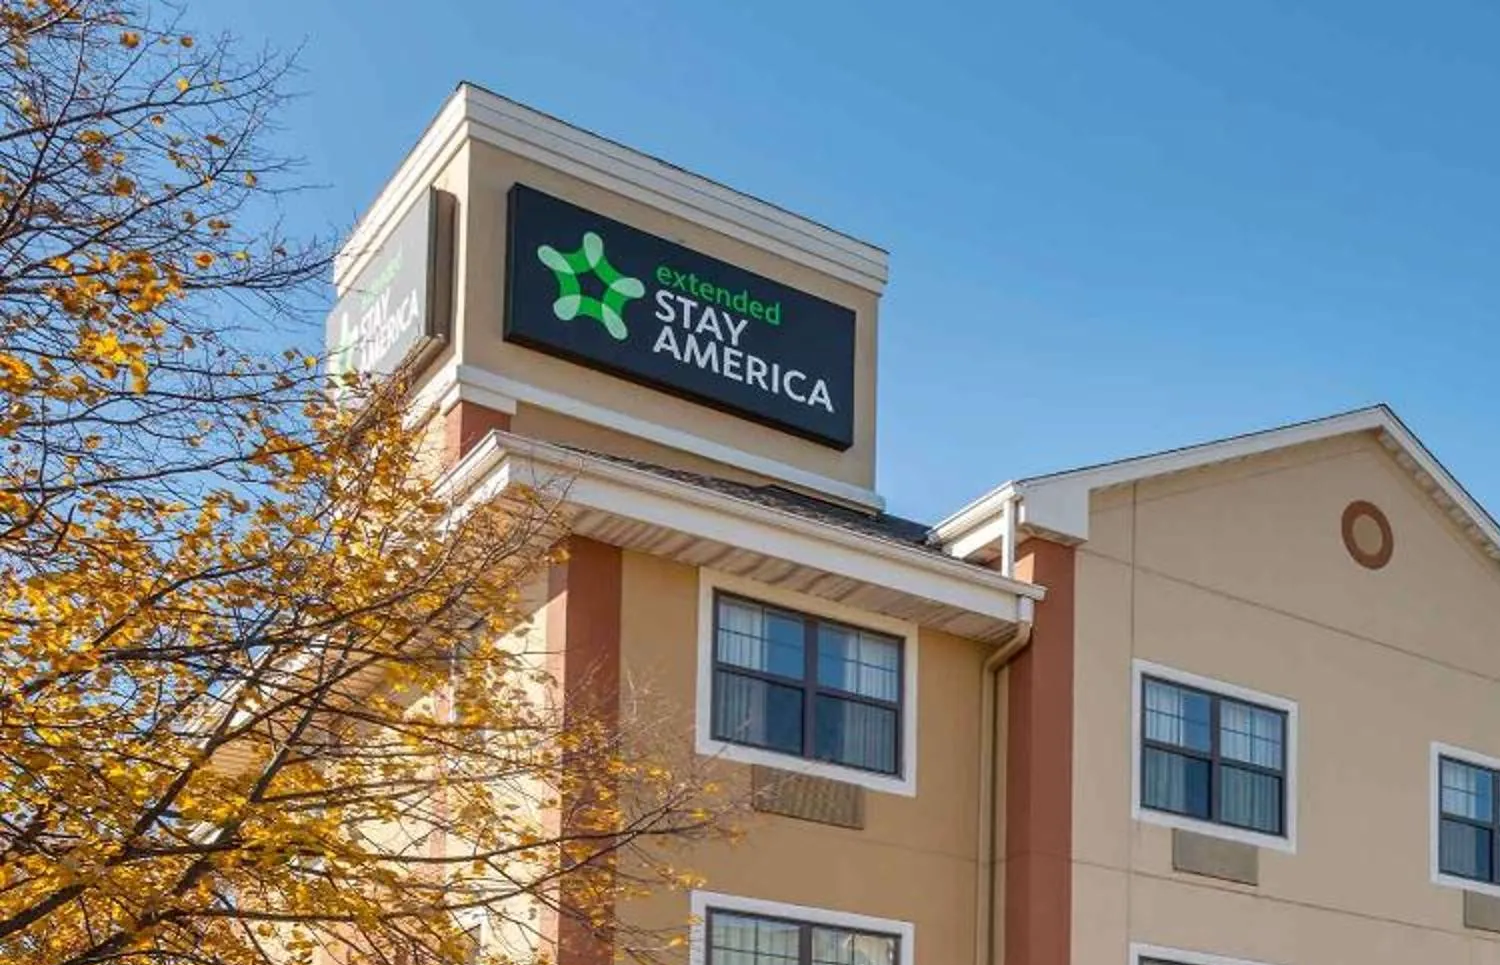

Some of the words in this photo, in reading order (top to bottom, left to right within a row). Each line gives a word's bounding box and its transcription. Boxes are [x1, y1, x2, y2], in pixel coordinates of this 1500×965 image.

[655, 289, 748, 347] STAY
[656, 264, 782, 326] extended
[652, 325, 835, 414] AMERICA
